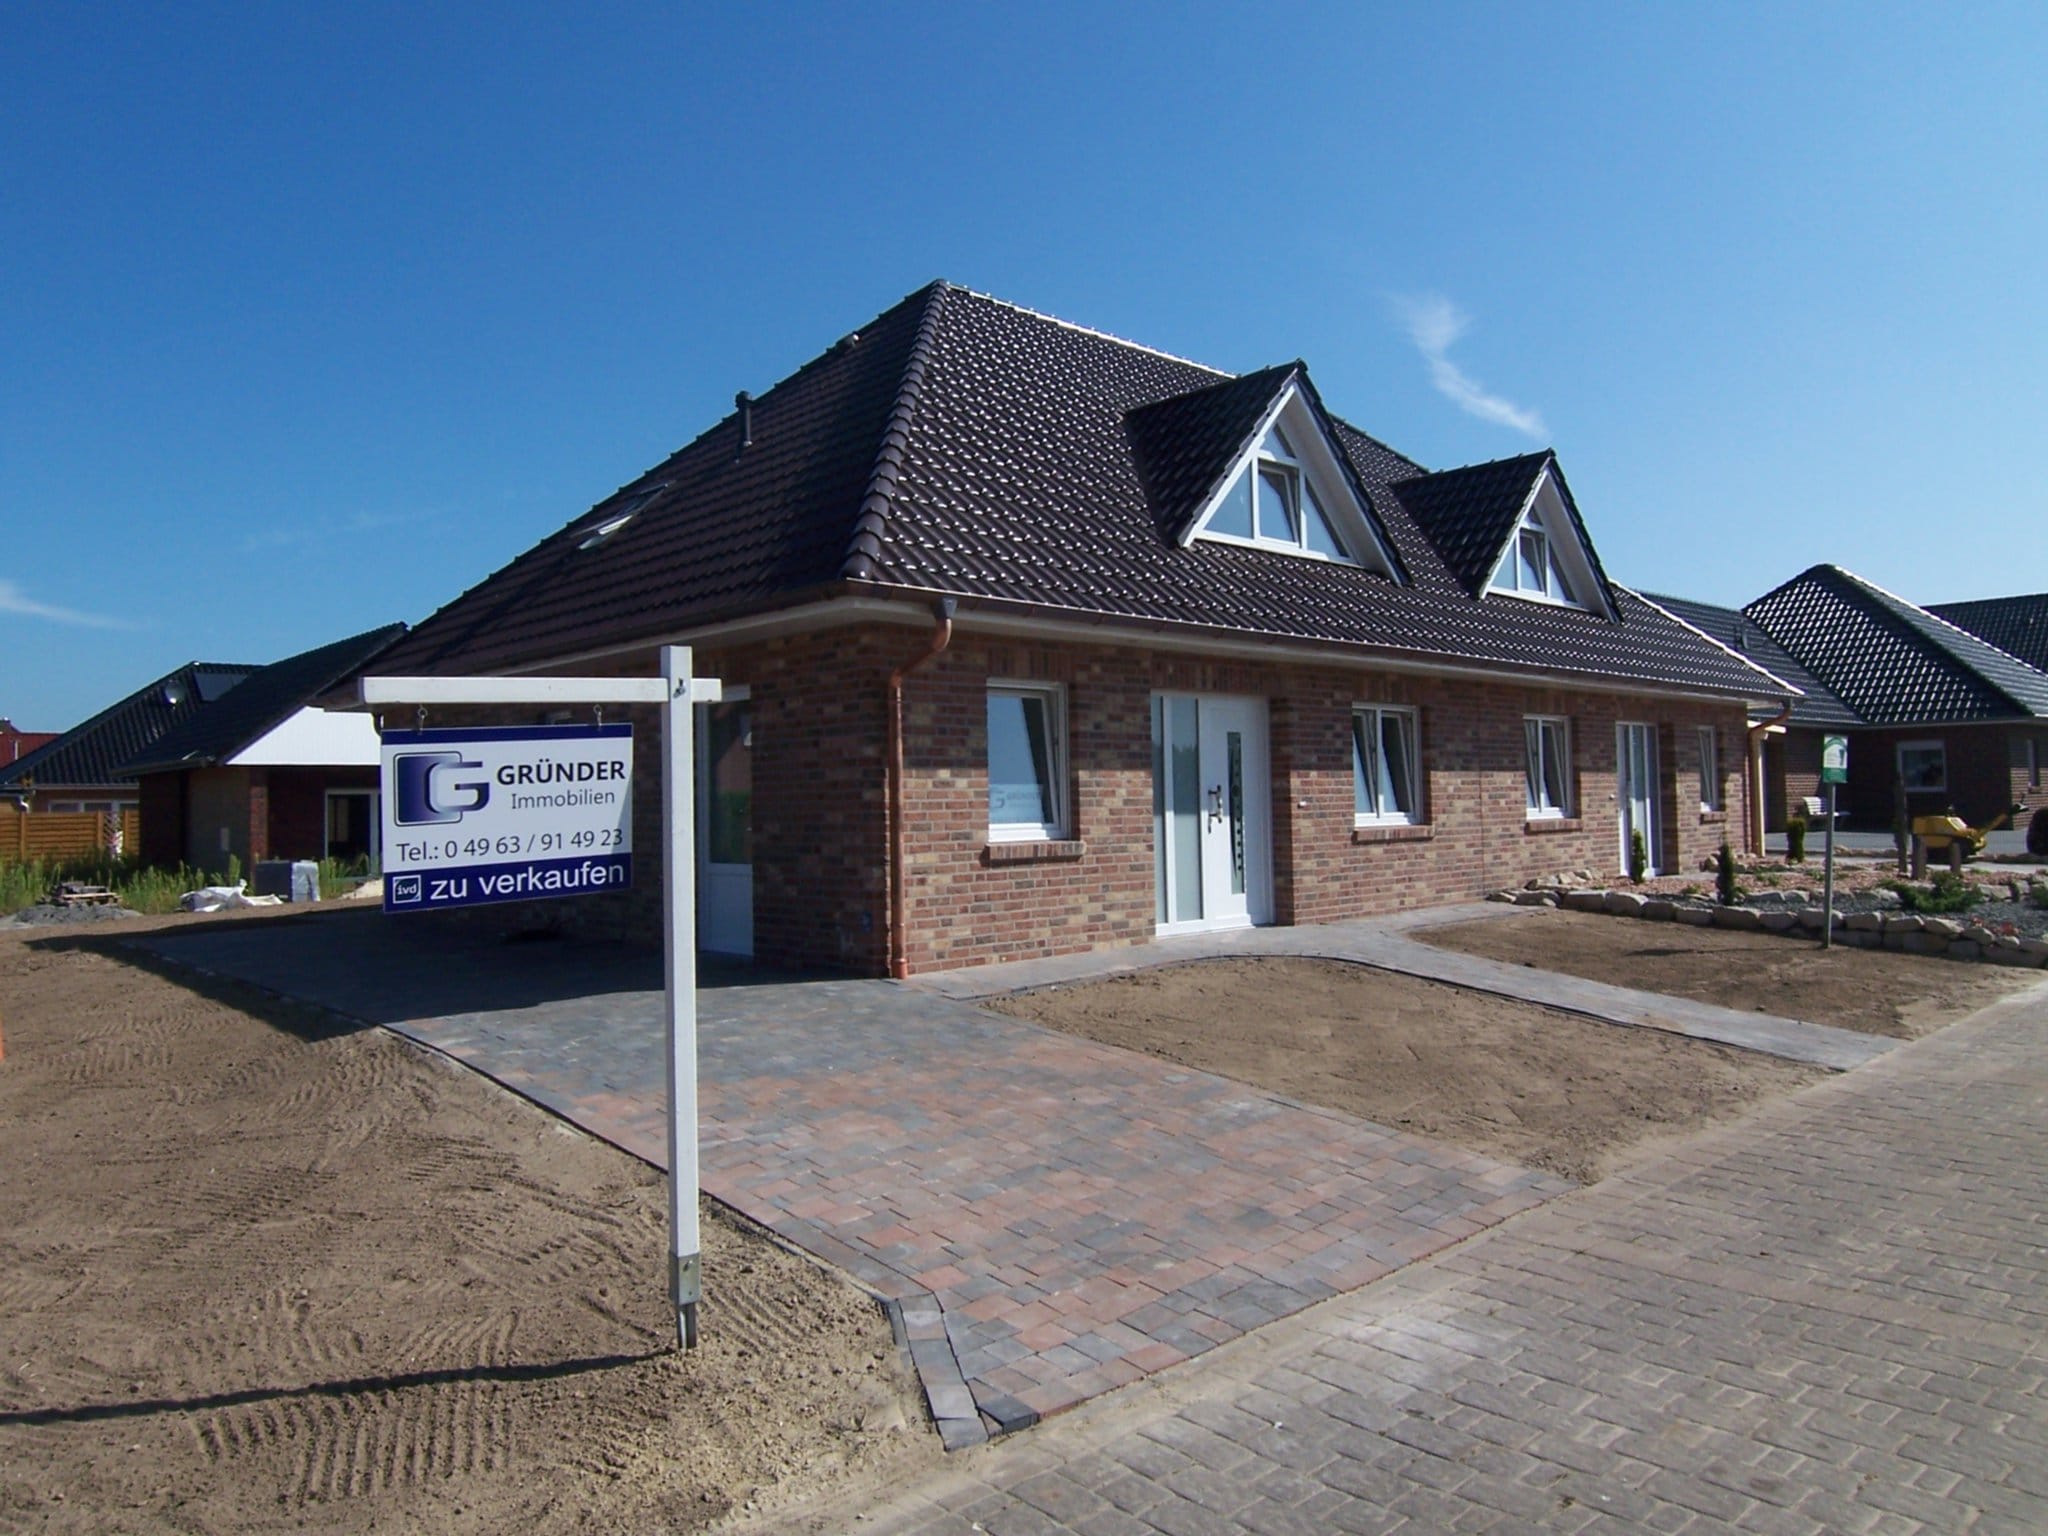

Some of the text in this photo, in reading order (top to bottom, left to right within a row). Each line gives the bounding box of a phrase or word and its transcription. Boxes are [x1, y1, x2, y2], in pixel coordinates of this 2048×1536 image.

[497, 760, 626, 785] GRÜNDER
[511, 790, 615, 809] Immobilien
[396, 842, 439, 862] Tel.:
[430, 862, 624, 900] zu verkaufen
